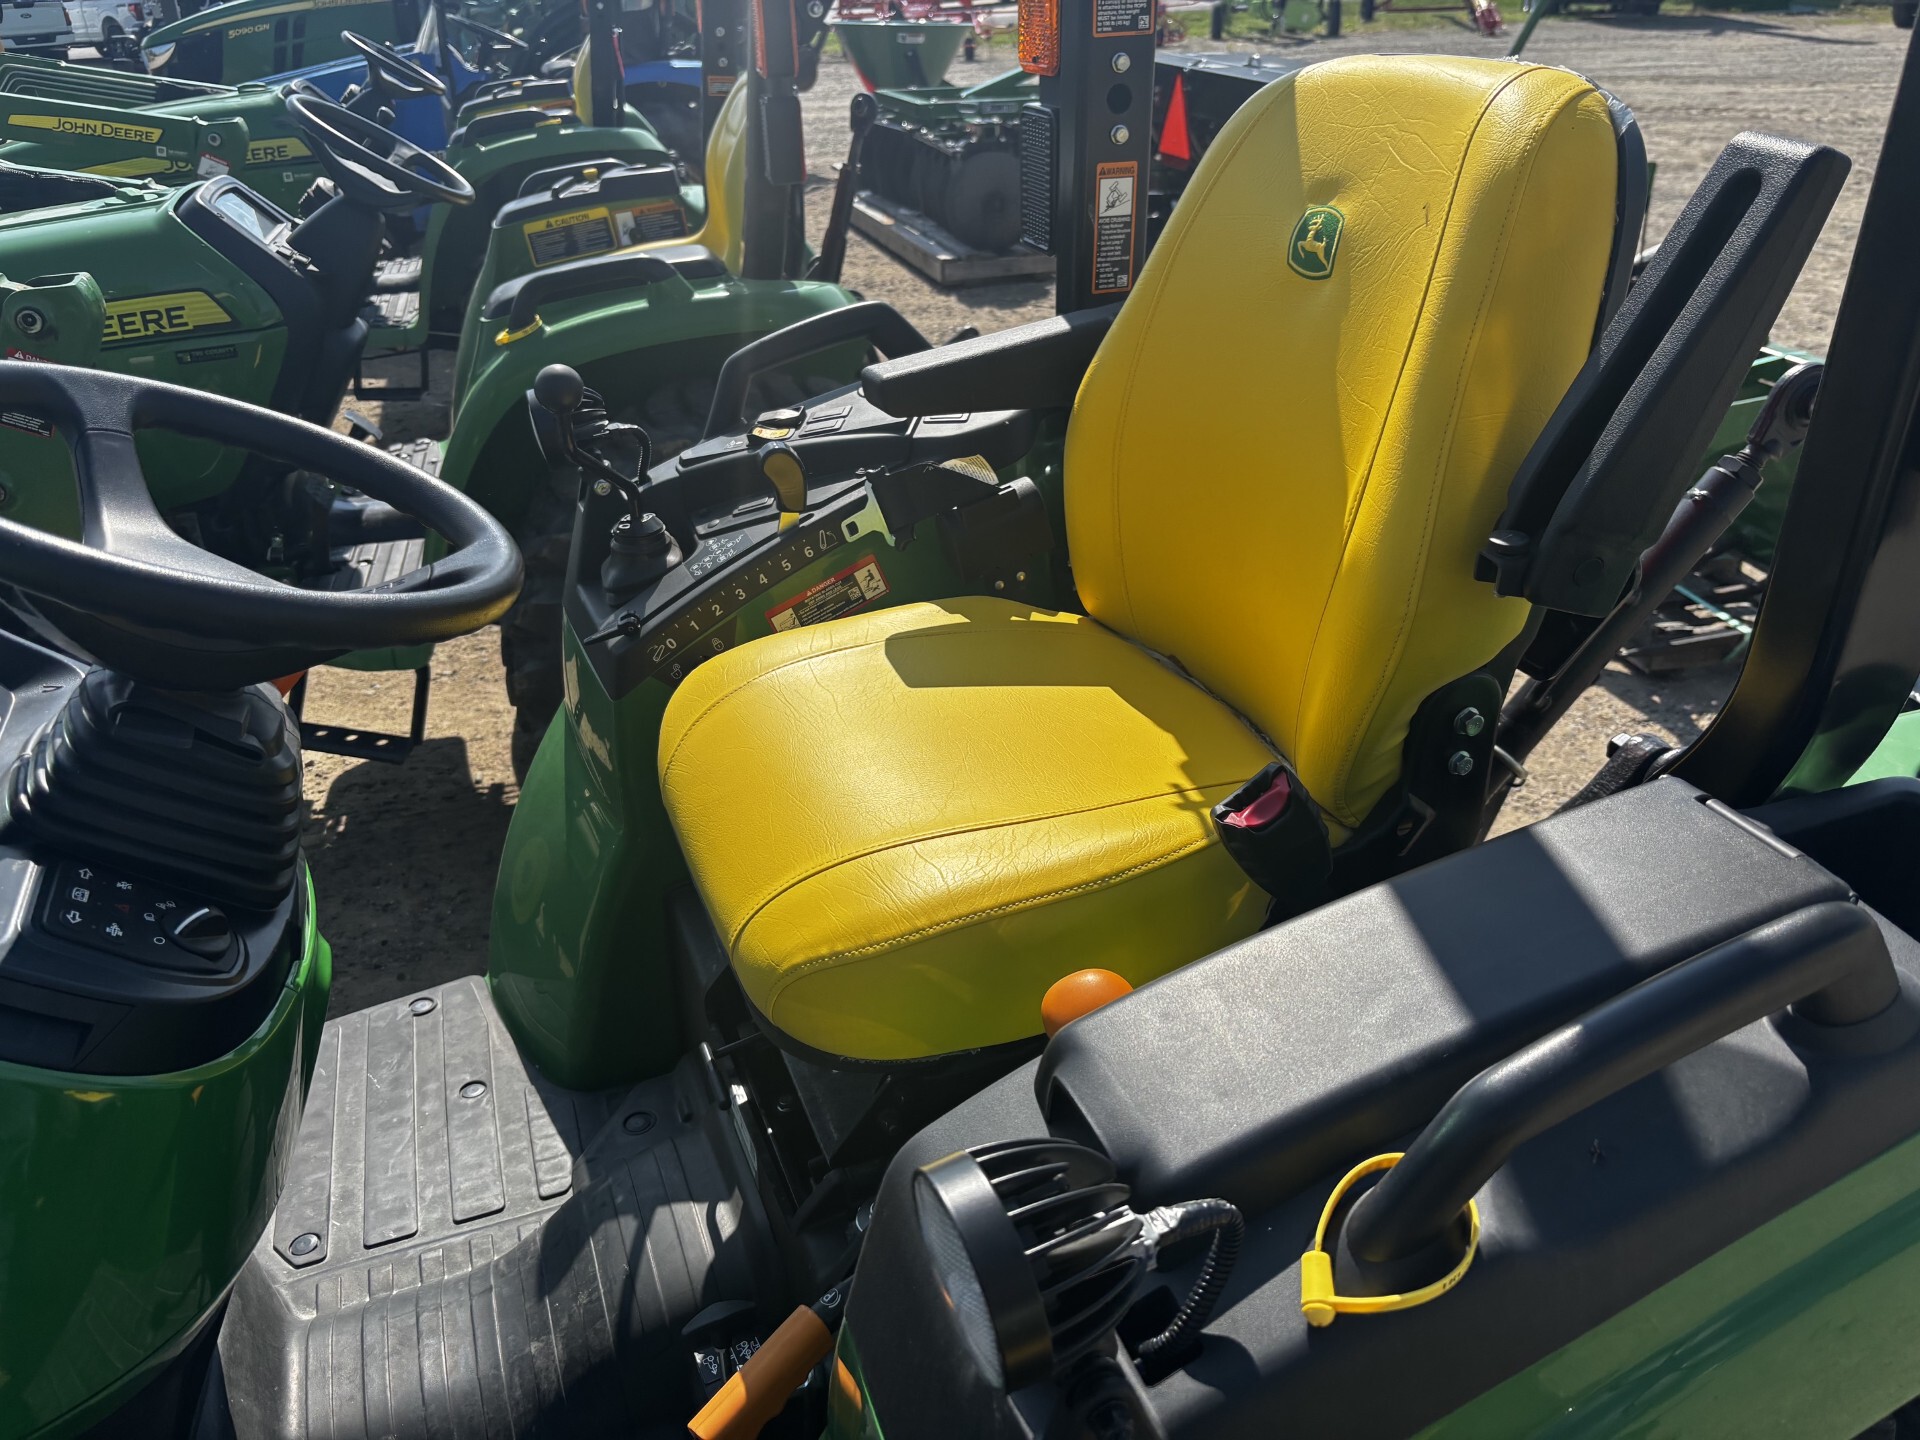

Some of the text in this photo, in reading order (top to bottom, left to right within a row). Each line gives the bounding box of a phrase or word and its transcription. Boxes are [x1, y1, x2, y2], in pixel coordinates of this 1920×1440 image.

[52, 118, 155, 141] JOHN DEERE
[1106, 167, 1135, 176] WARNING
[554, 213, 590, 227] CAUTION
[812, 578, 836, 594] DANGER
[665, 547, 814, 650] 0 1 2 3 4 5 6
